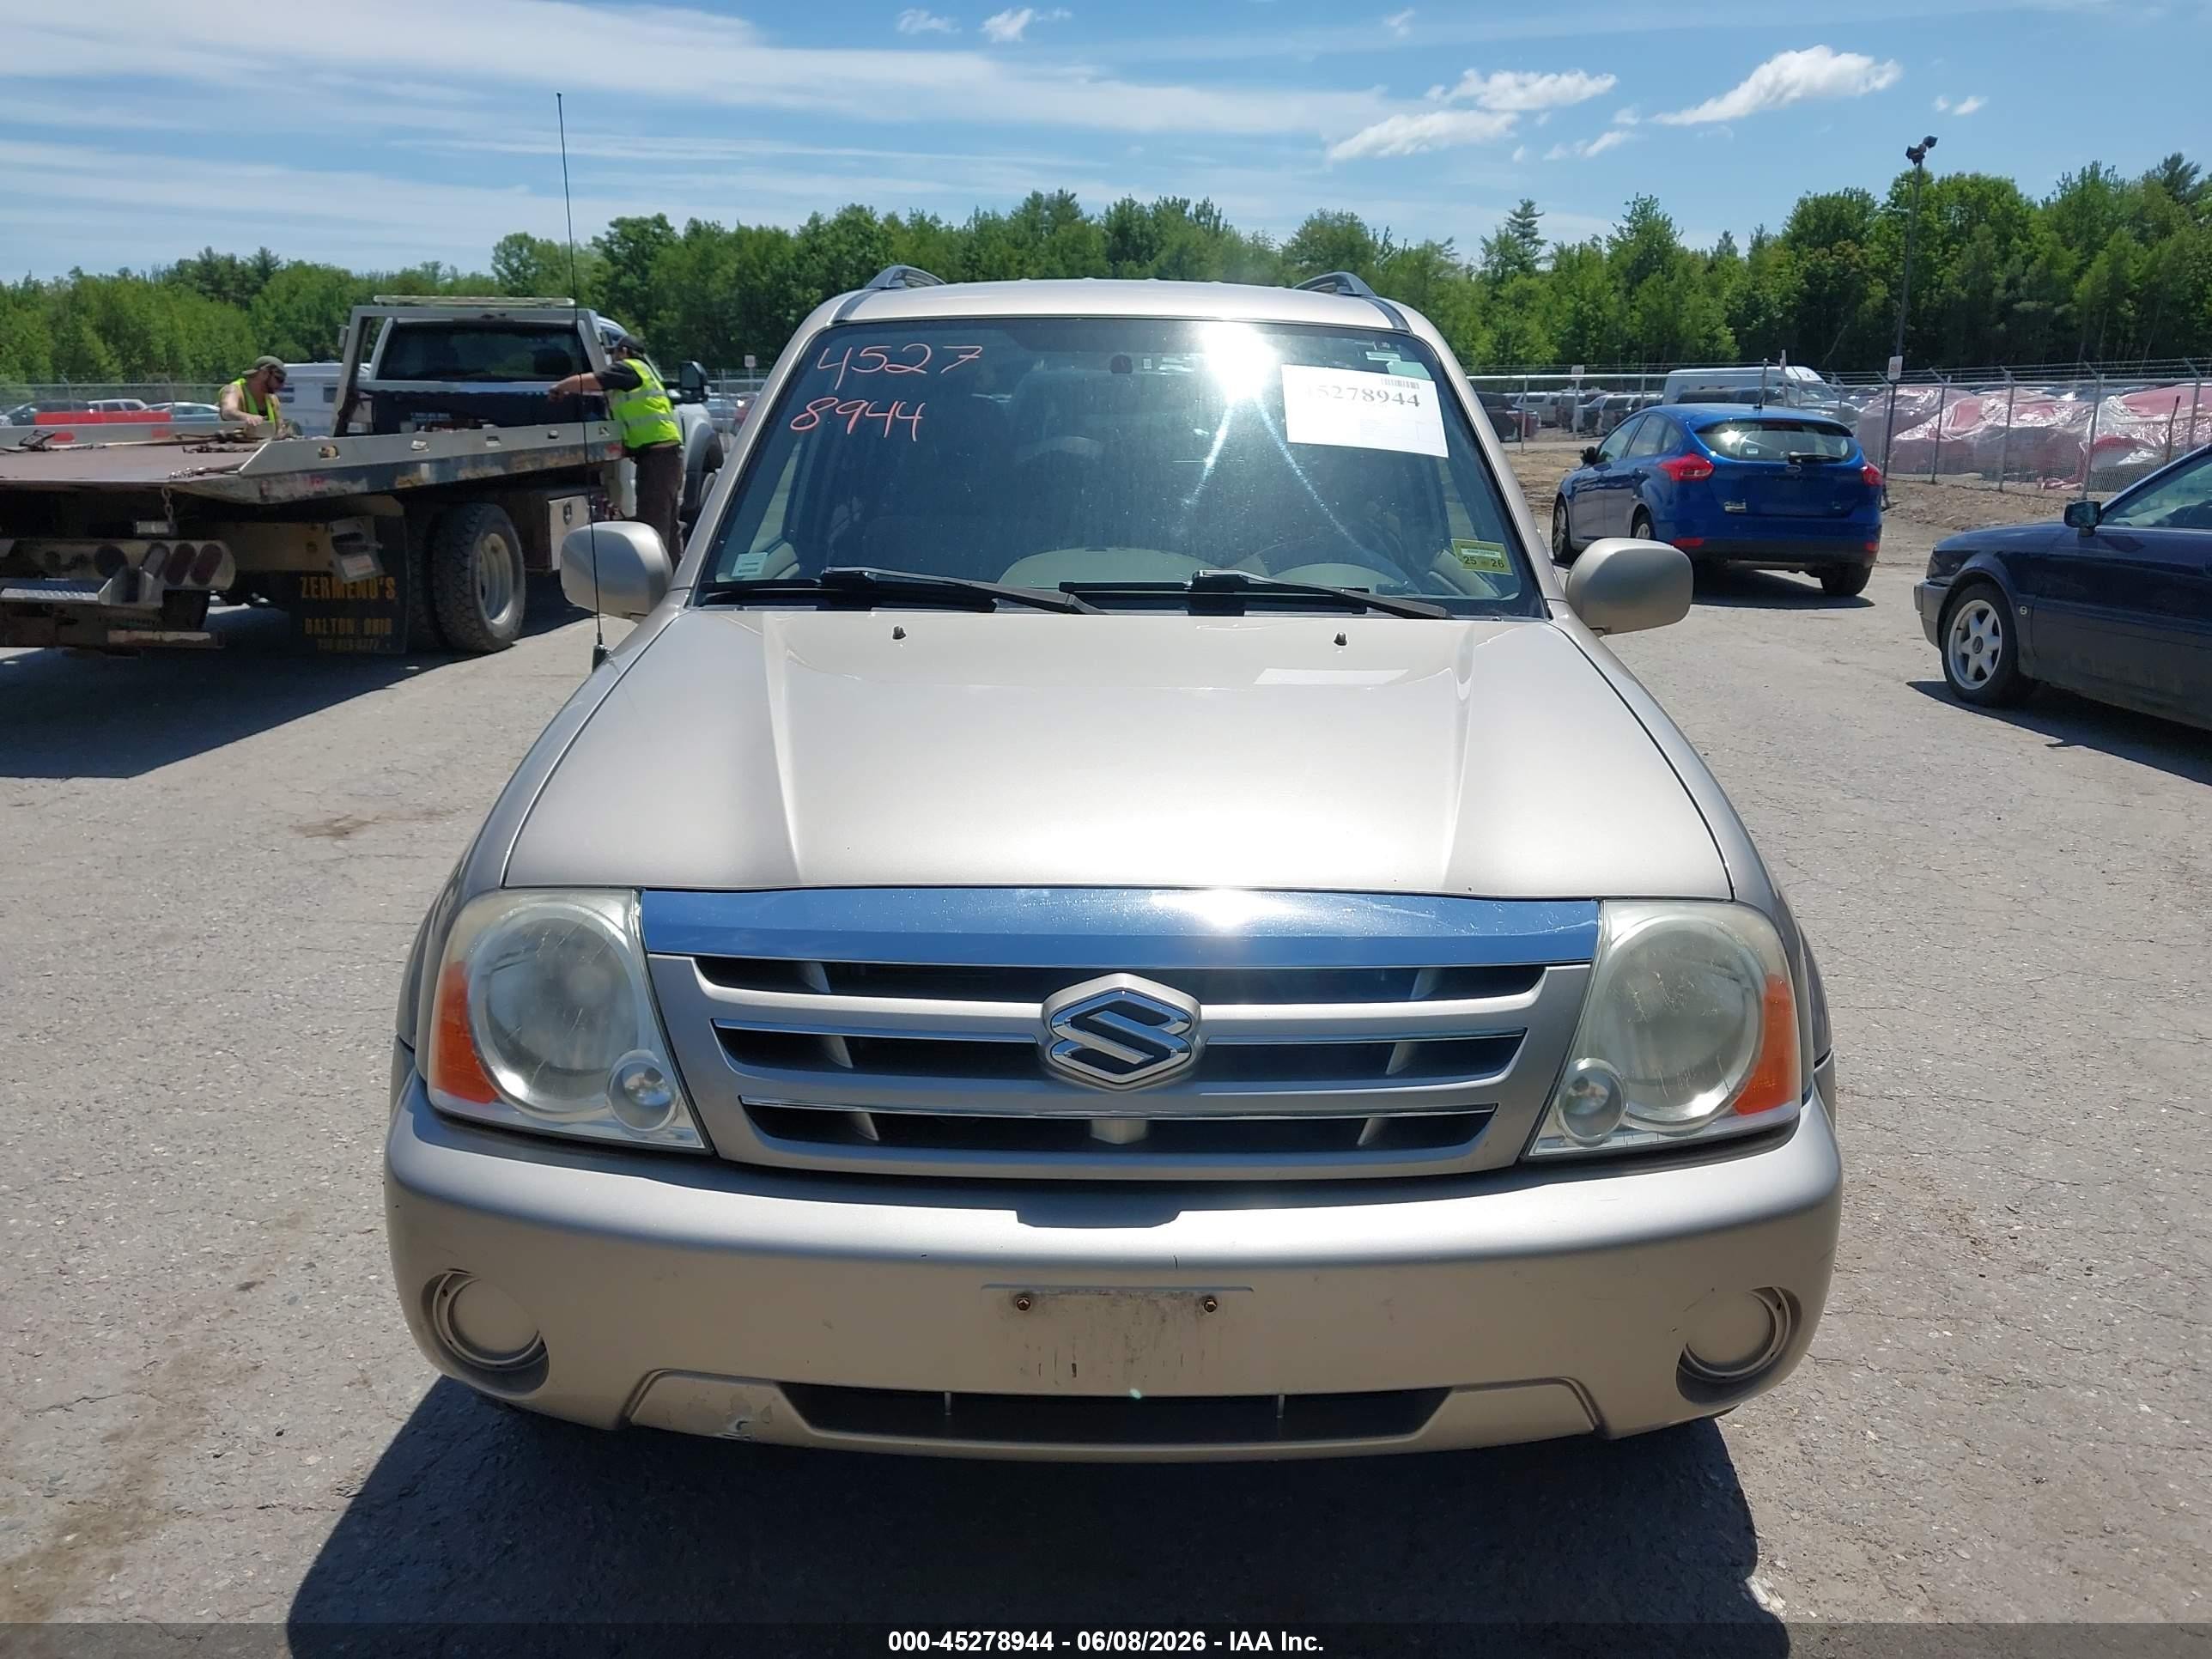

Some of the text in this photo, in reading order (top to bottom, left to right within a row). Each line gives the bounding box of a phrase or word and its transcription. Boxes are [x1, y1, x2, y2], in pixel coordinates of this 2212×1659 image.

[817, 343, 983, 391] 4527
[789, 396, 927, 442] 8944
[1463, 556, 1505, 568] 25 26
